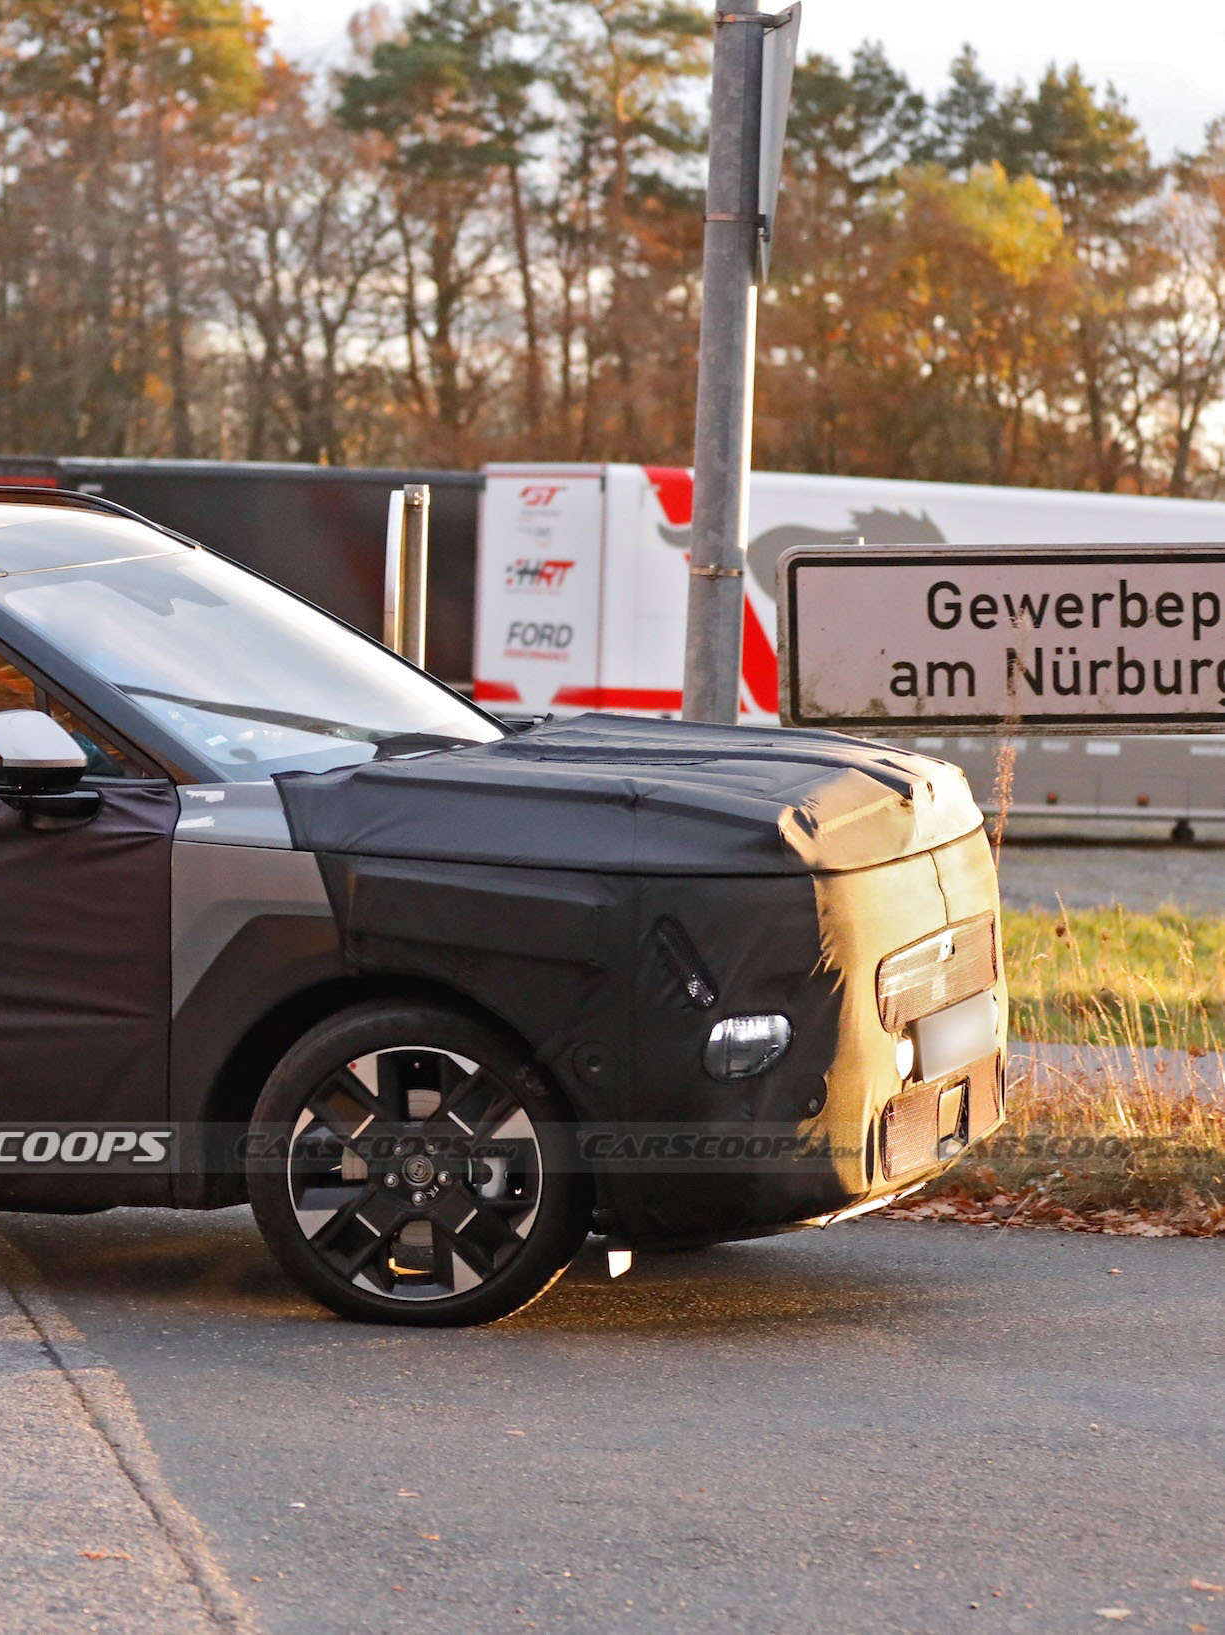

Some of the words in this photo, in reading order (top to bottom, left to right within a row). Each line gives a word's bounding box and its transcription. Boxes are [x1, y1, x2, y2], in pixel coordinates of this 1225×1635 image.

[927, 579, 1221, 641] Gewerbep
[506, 621, 574, 649] FORD
[889, 661, 975, 697] am
